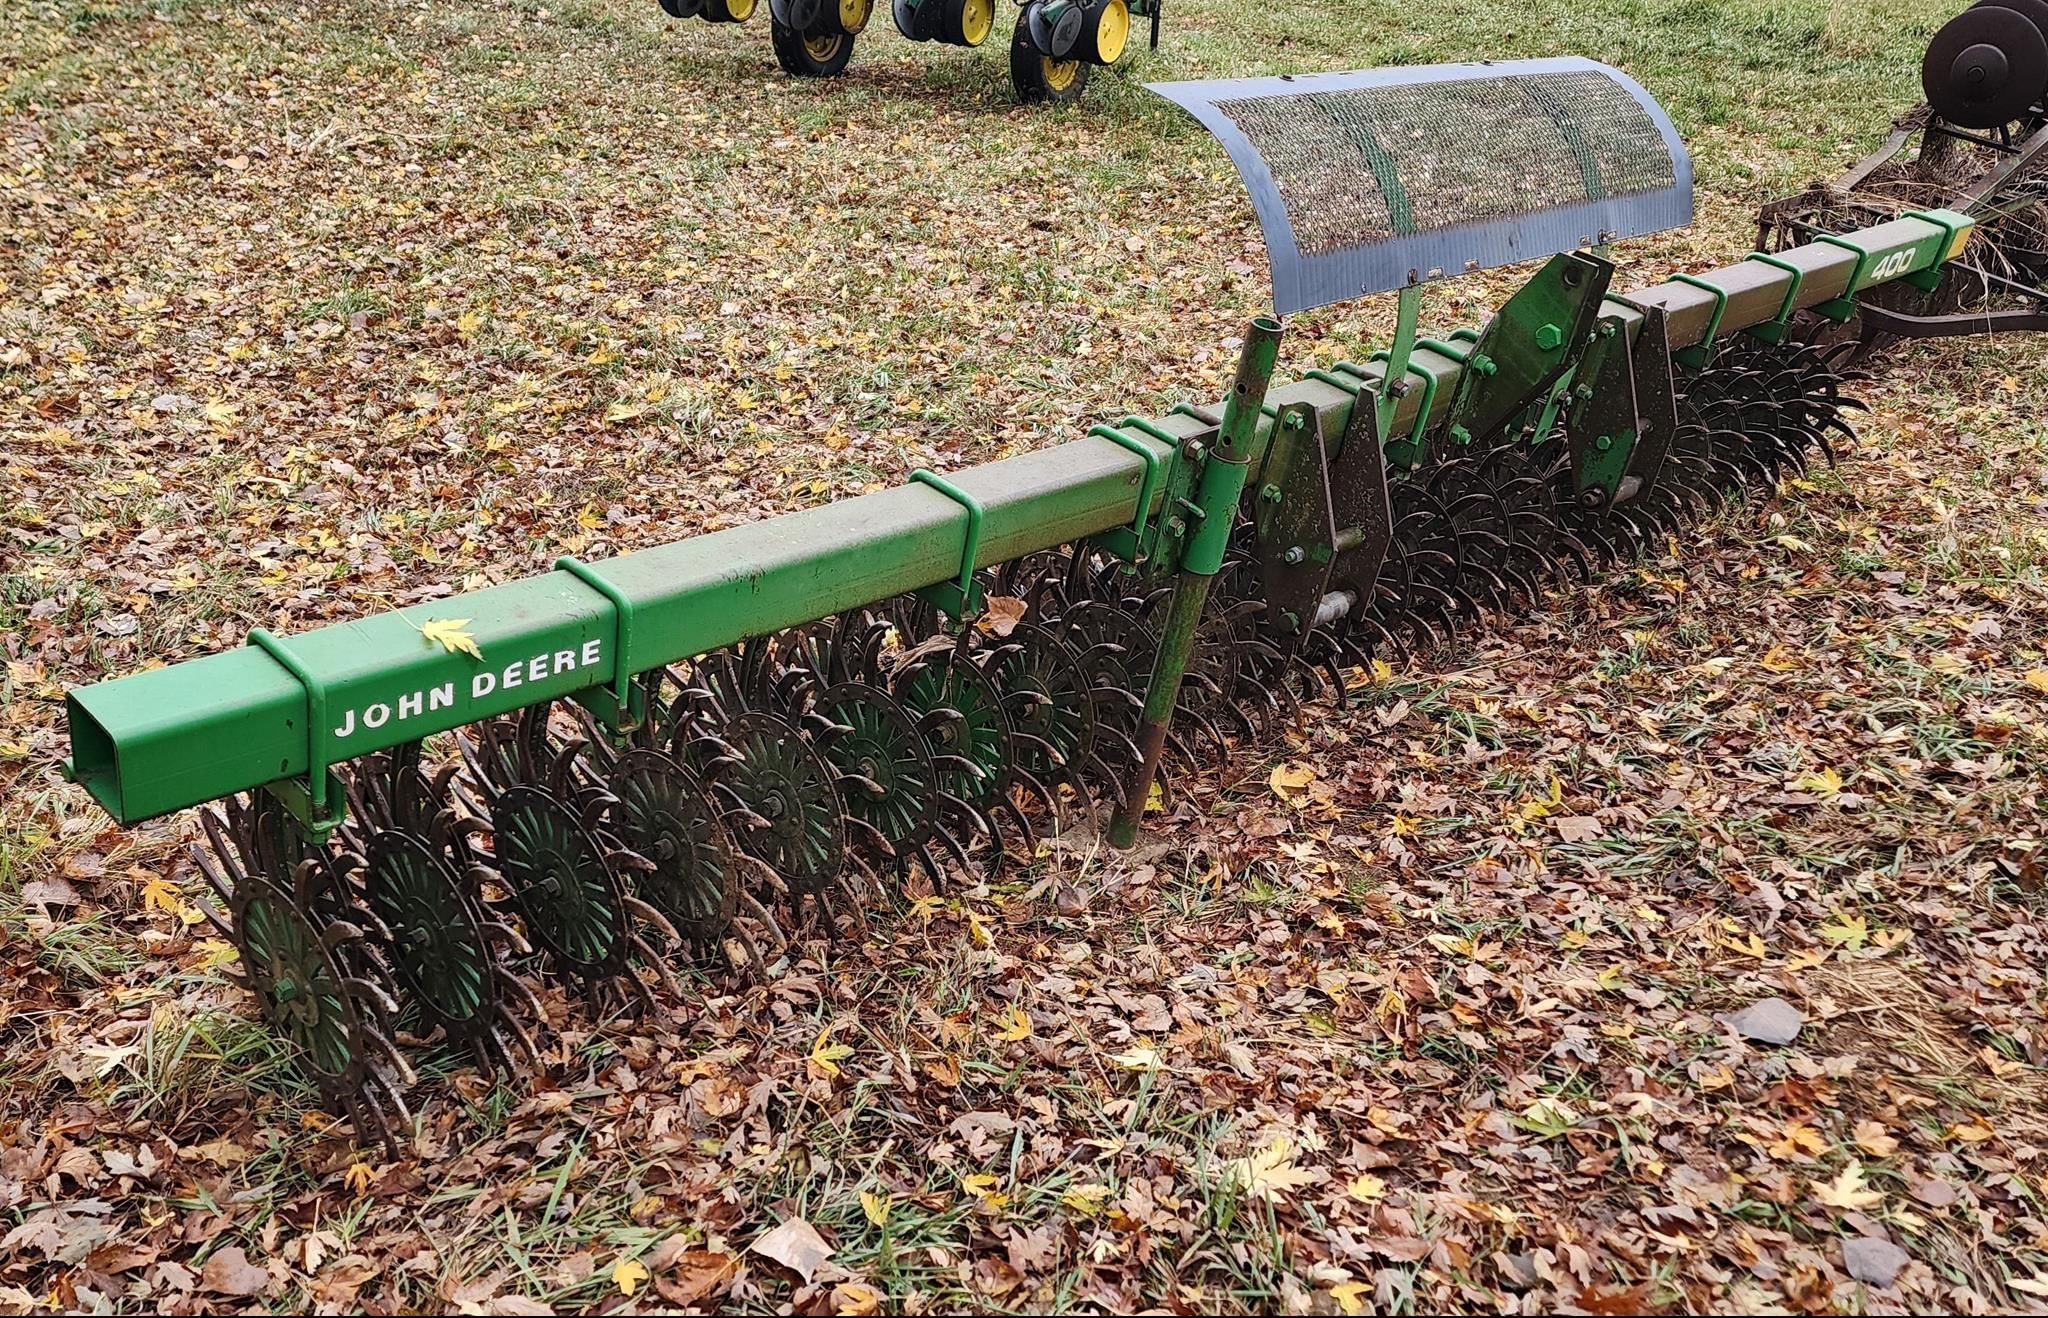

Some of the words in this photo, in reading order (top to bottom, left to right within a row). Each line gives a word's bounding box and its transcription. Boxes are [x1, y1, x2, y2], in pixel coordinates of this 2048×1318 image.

[1871, 248, 1916, 280] 400
[334, 683, 454, 738] JOHN
[471, 639, 601, 698] DEERE
